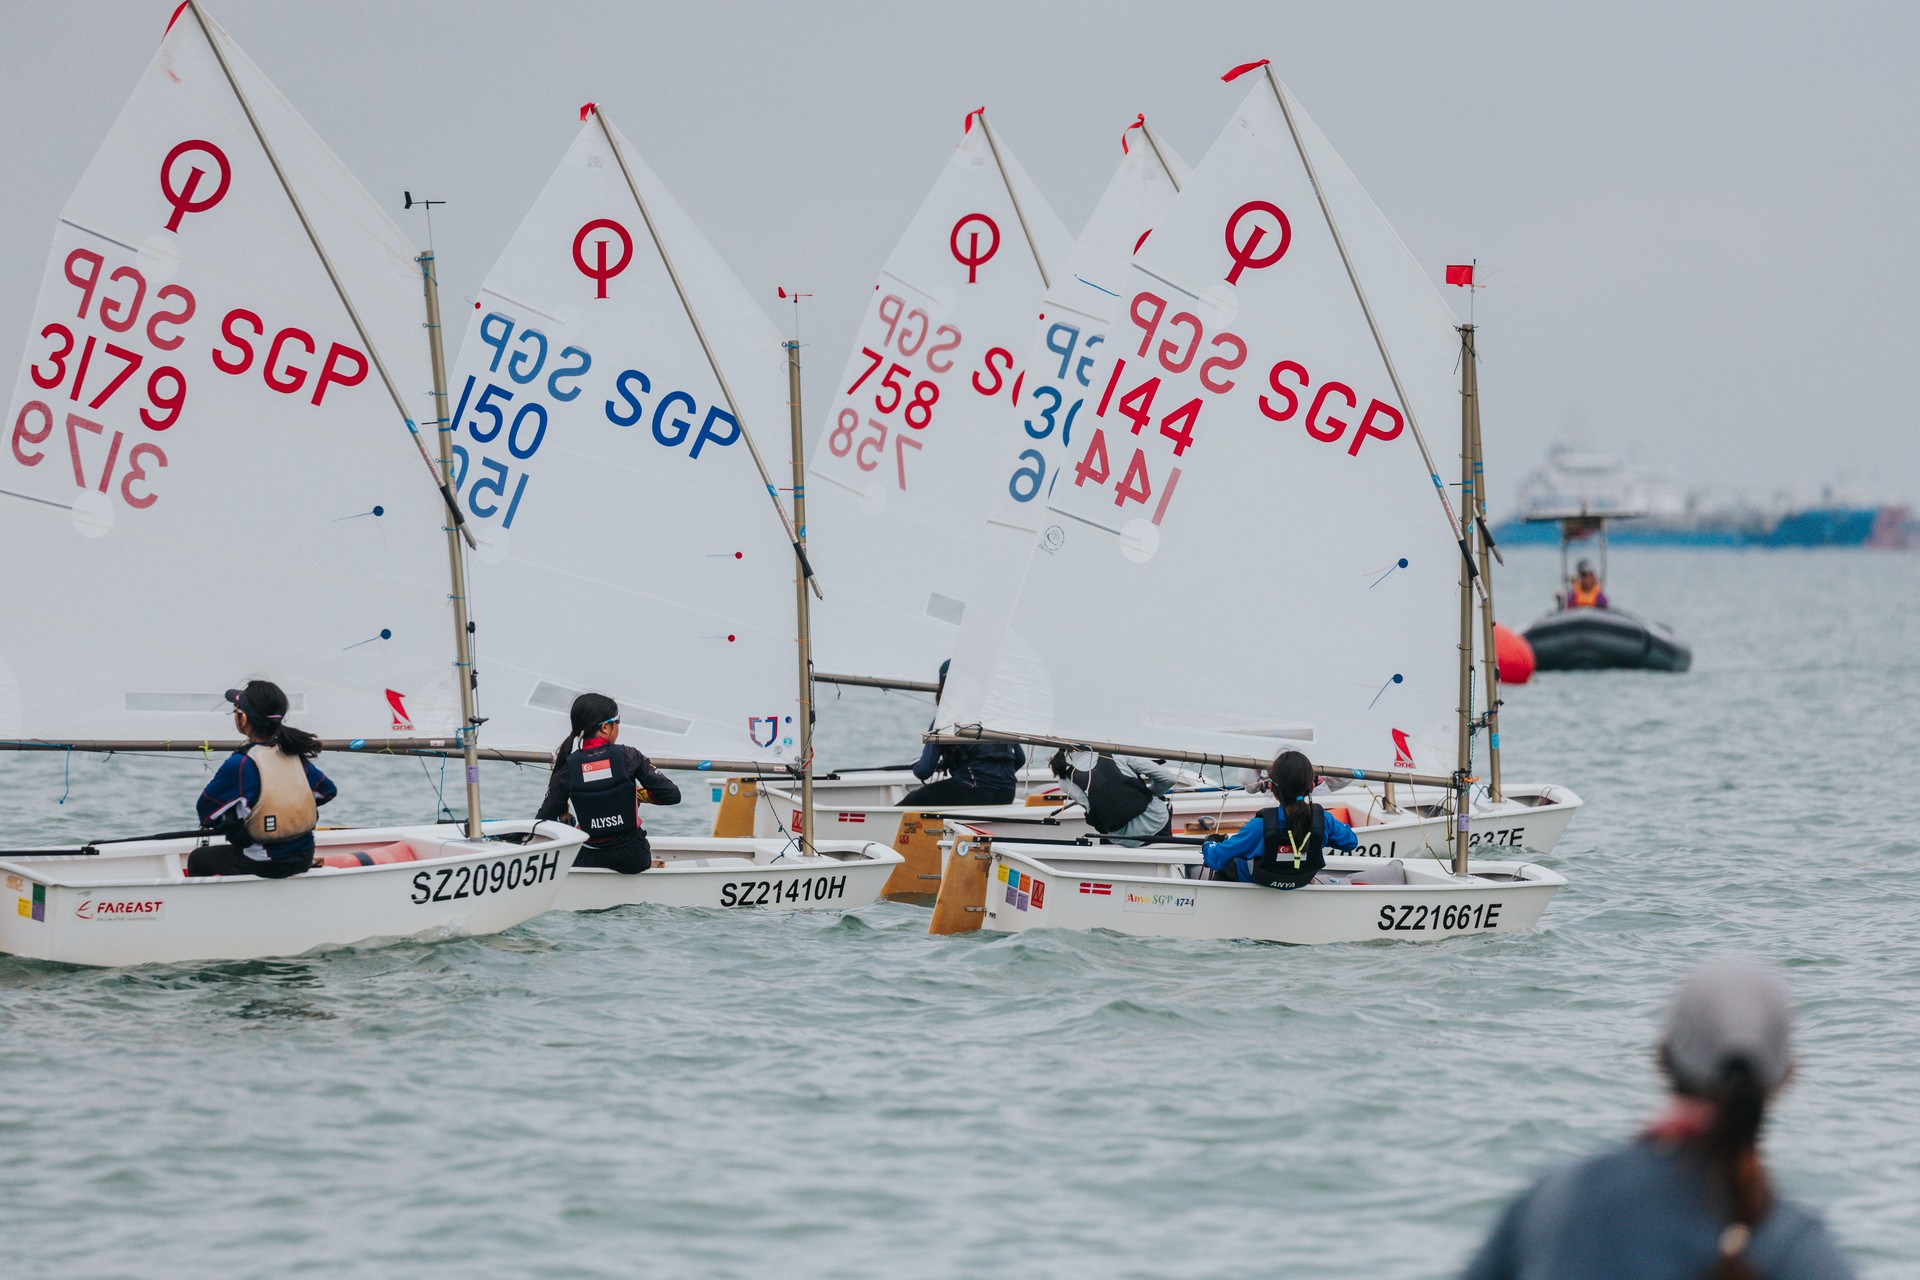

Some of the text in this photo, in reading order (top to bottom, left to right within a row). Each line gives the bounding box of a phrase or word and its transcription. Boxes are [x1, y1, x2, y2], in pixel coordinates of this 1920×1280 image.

[31, 323, 187, 431] 3179
[212, 308, 369, 407] SGP
[847, 346, 940, 430] 758
[450, 375, 548, 460] 150
[605, 369, 742, 460] SGP
[1096, 358, 1204, 457] 144
[1258, 360, 1405, 457] SGP
[591, 814, 624, 829] ALYSSA
[97, 901, 163, 913] FAREAST
[411, 850, 560, 905] SZ20905H
[720, 875, 847, 907] SZ21410H
[1377, 903, 1503, 931] SZ21661E
